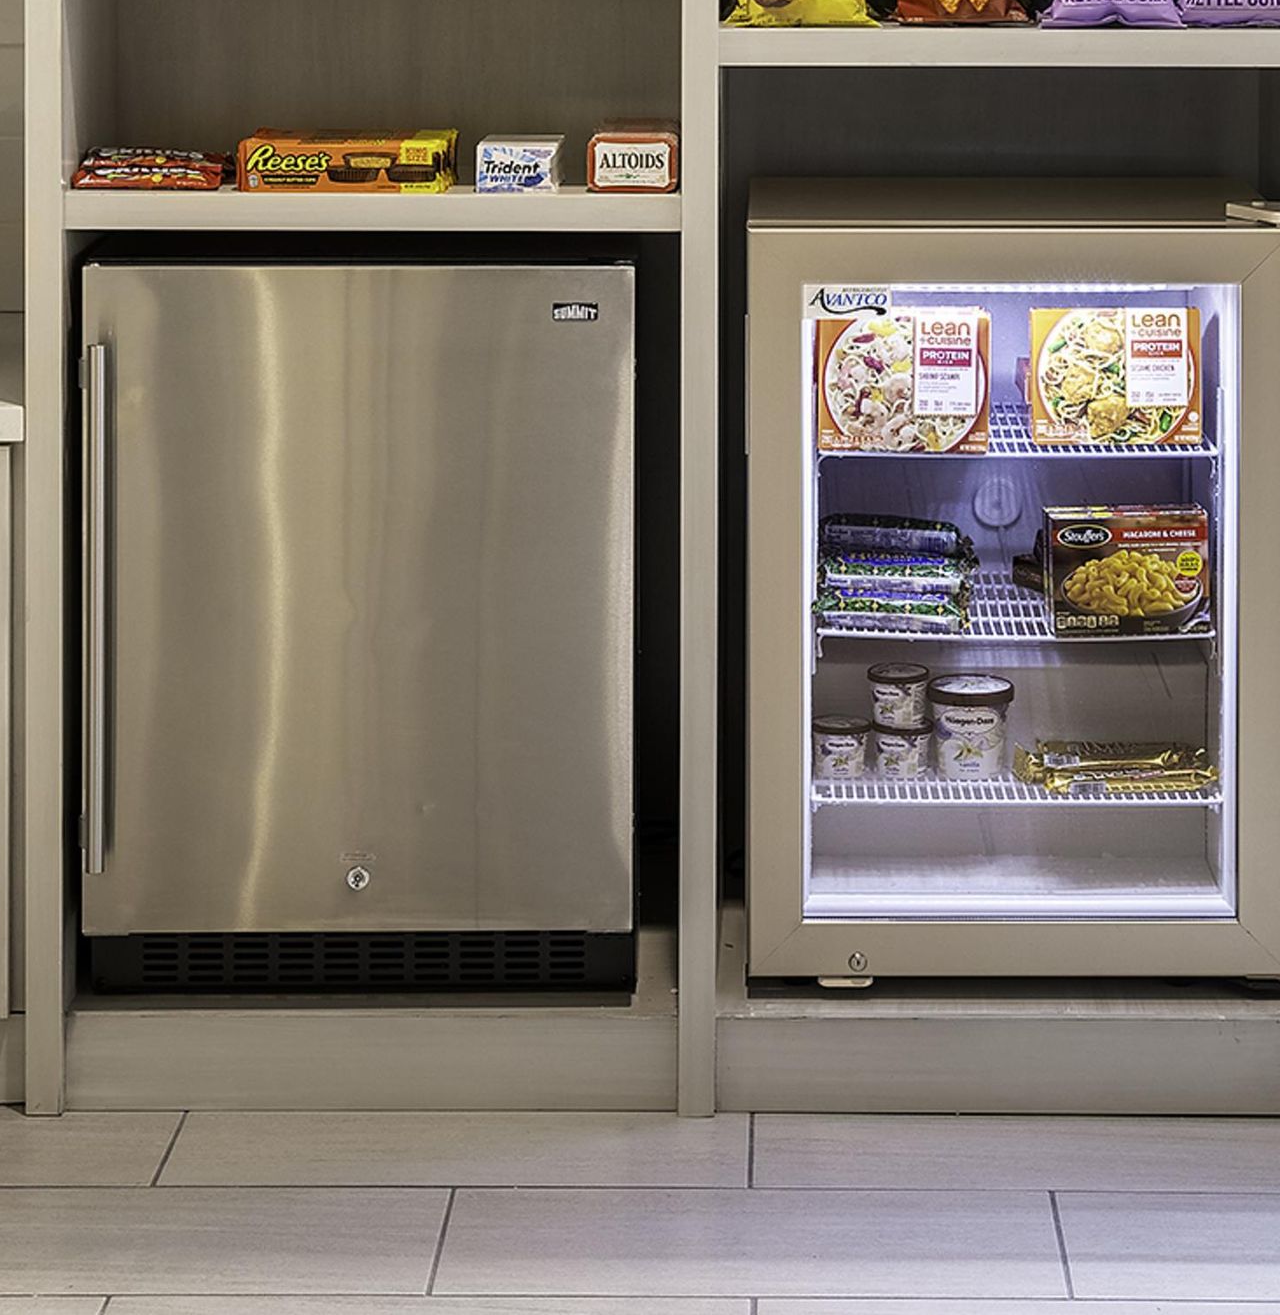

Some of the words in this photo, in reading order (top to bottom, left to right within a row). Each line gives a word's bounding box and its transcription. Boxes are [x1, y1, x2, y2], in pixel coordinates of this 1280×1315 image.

[247, 145, 332, 173] Reese's
[600, 152, 664, 169] ALTOIDS
[484, 160, 540, 175] Trident
[810, 288, 887, 309] AVANTCO
[1132, 313, 1181, 327] Lean
[921, 320, 970, 335] Lean
[1138, 327, 1182, 337] cuisine
[927, 335, 971, 345] cuisine
[1133, 342, 1180, 352] PROTEIN
[923, 351, 969, 360] PROTEIN
[1064, 530, 1106, 543] Stouffer's
